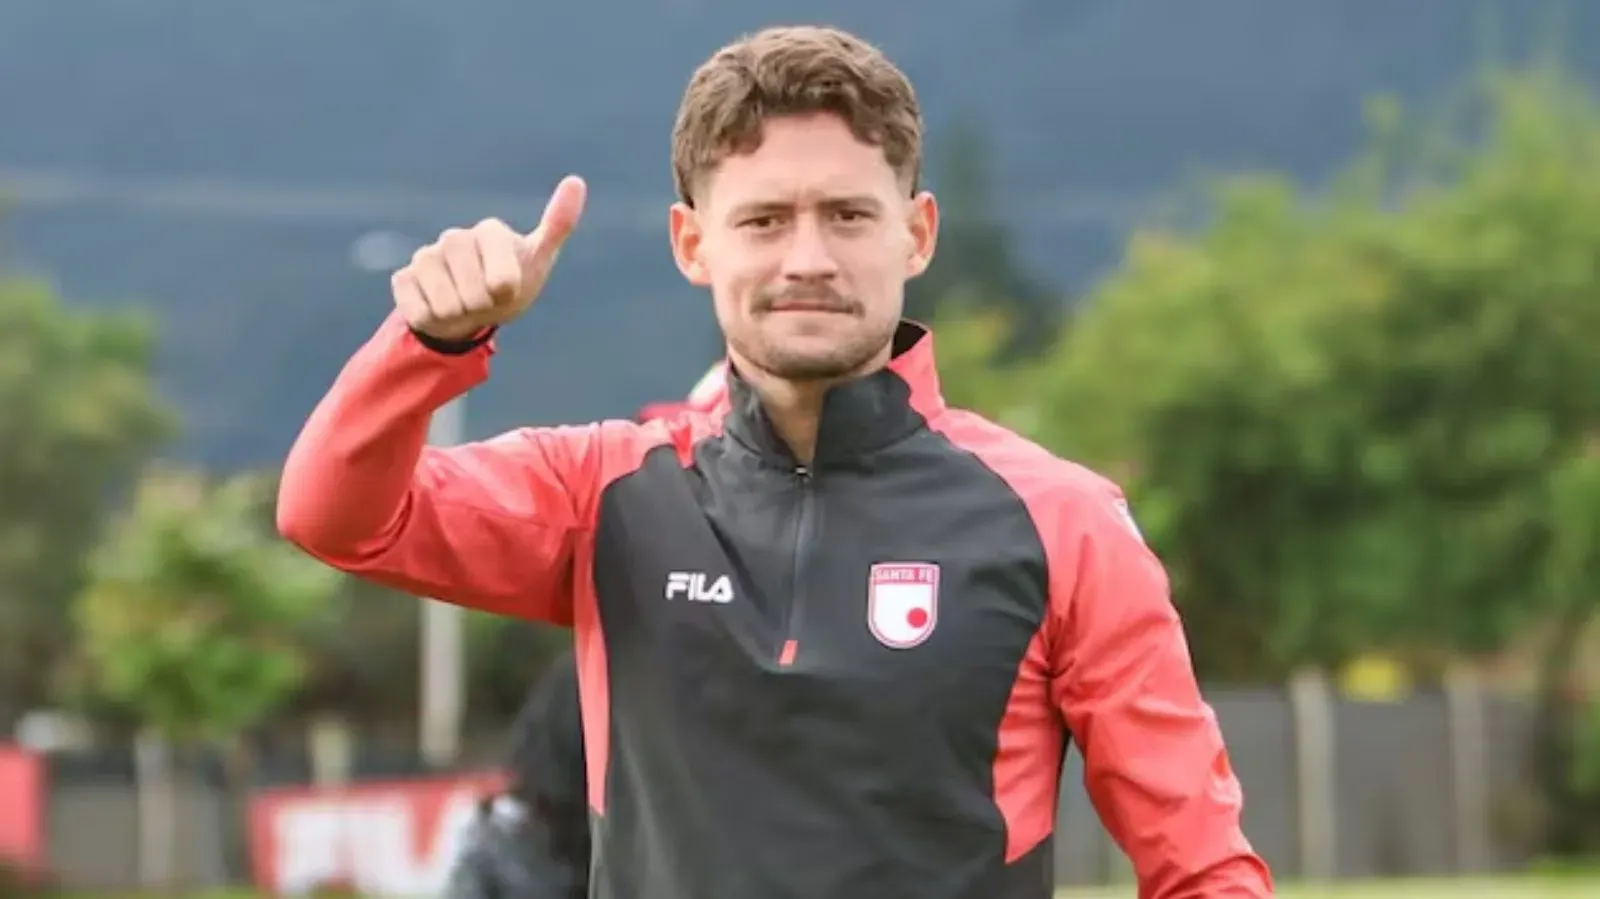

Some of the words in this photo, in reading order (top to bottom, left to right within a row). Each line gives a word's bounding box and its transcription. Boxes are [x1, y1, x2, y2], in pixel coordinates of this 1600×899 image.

[874, 567, 914, 581] SANTA
[918, 567, 934, 581] FE
[665, 572, 734, 603] FILA
